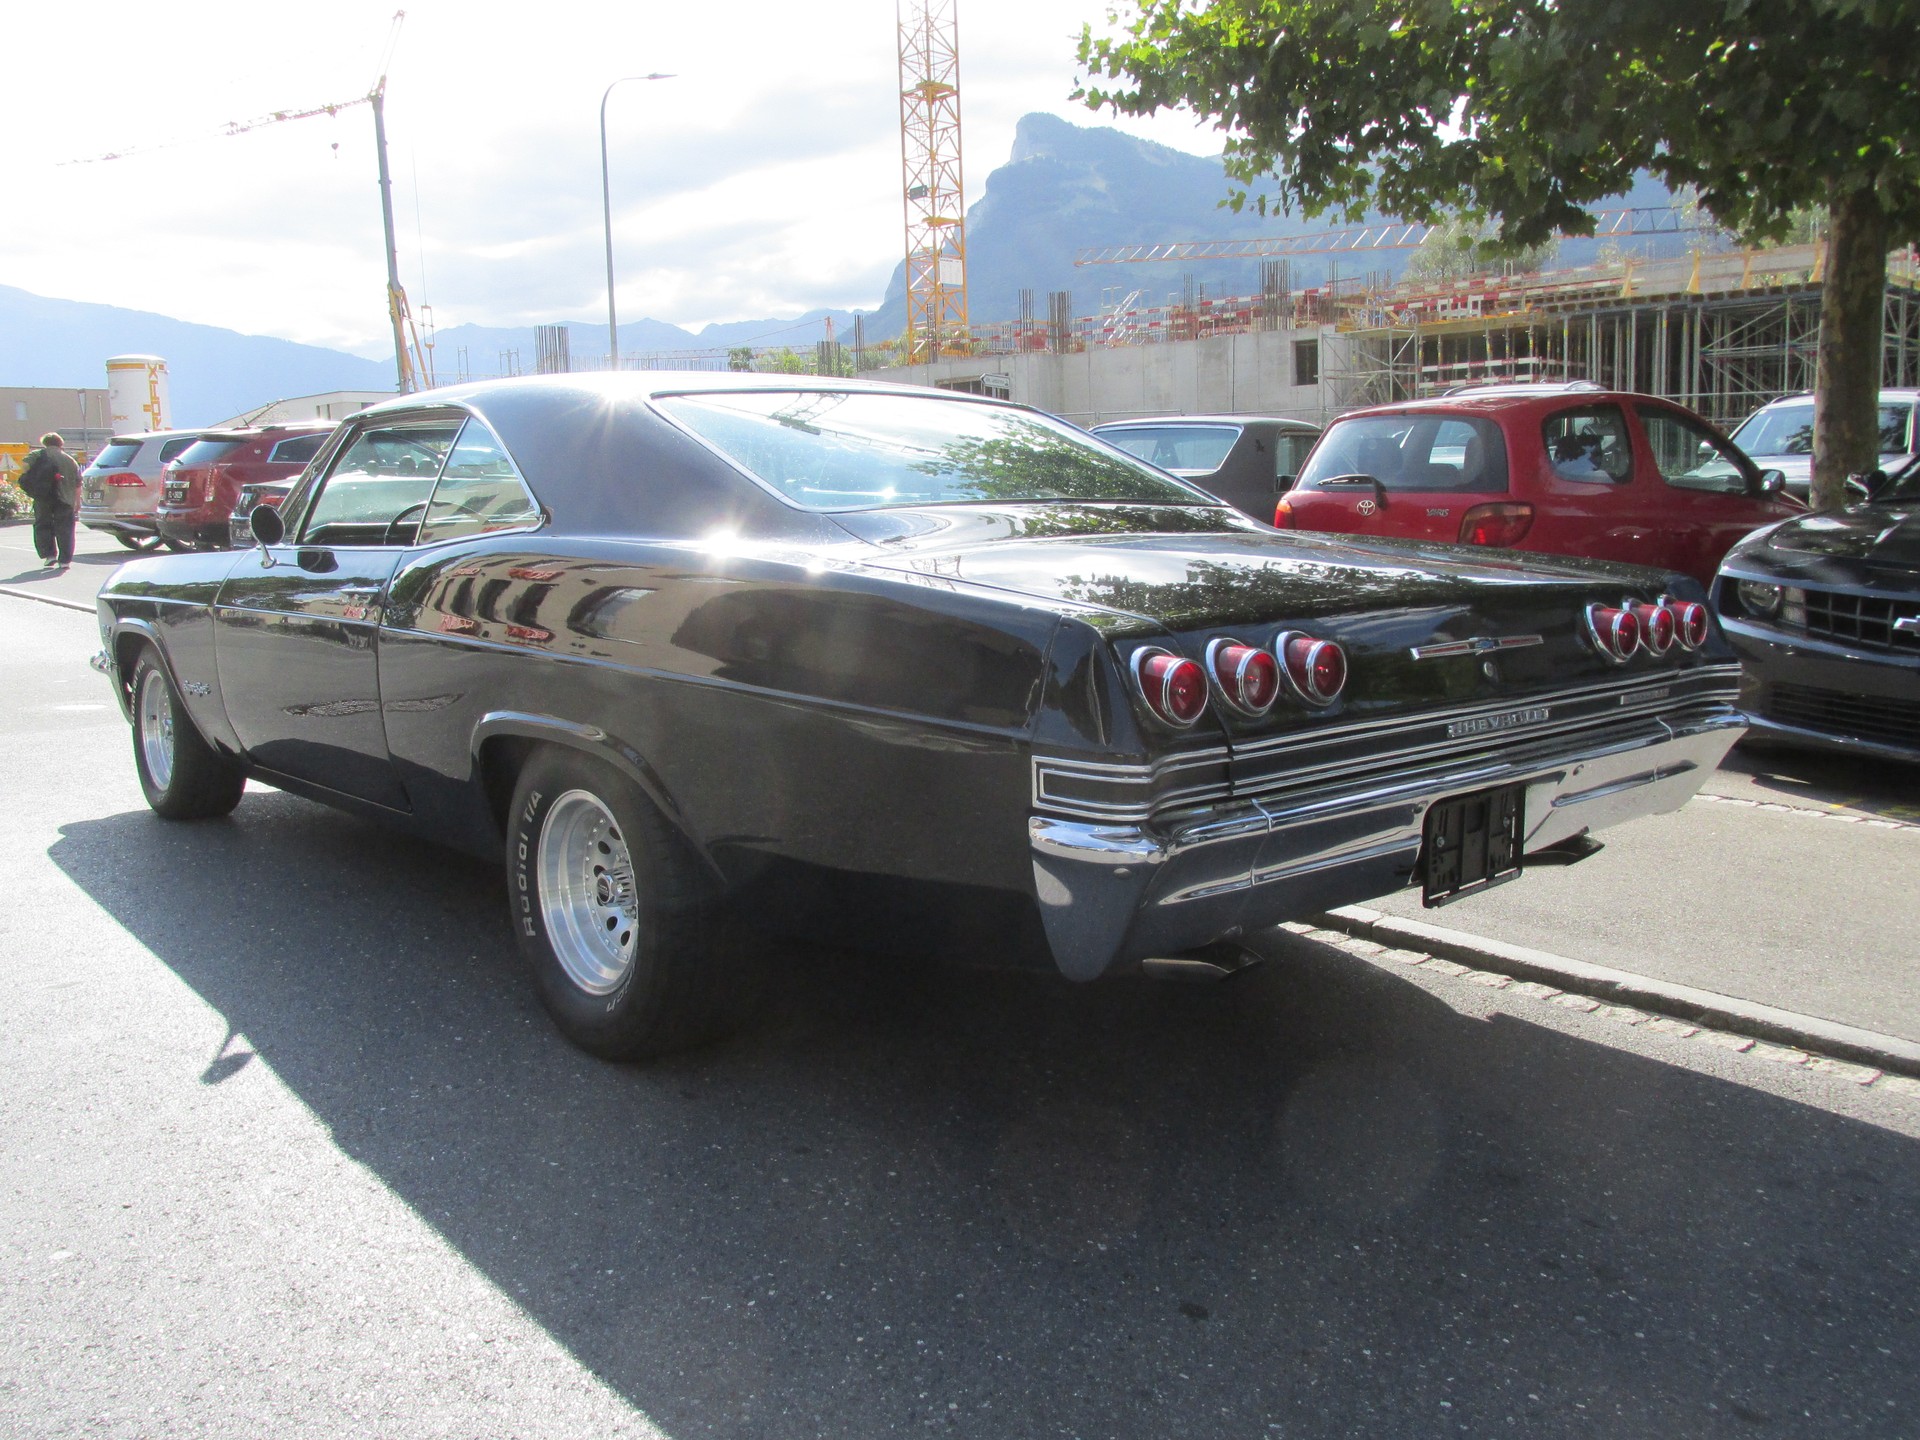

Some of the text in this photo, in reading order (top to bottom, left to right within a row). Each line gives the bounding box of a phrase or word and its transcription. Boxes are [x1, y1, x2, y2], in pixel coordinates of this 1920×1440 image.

[1426, 508, 1450, 518] YARIS
[518, 790, 543, 937] Radial T/A
